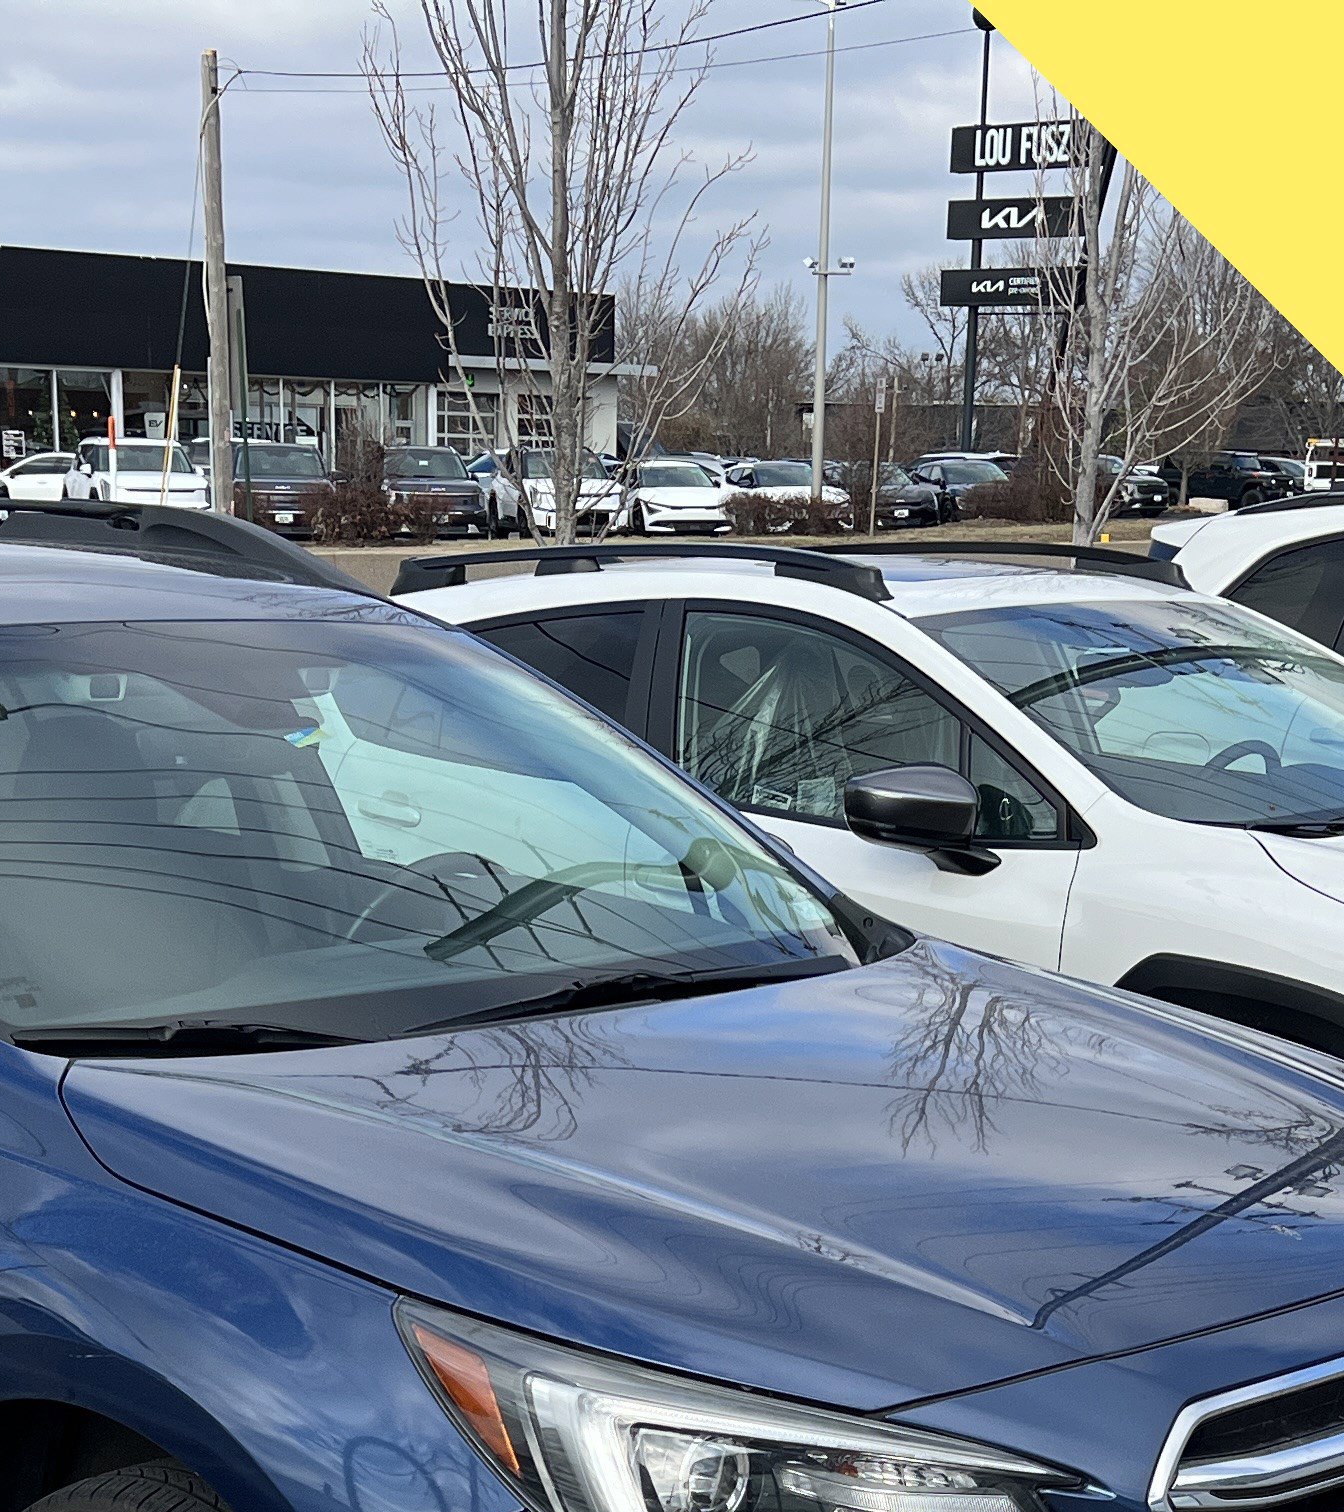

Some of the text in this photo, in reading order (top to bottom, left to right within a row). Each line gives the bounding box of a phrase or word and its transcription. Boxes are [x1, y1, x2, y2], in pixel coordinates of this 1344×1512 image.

[974, 124, 1072, 167] LOU FUSZ
[488, 306, 536, 321] SERVIC
